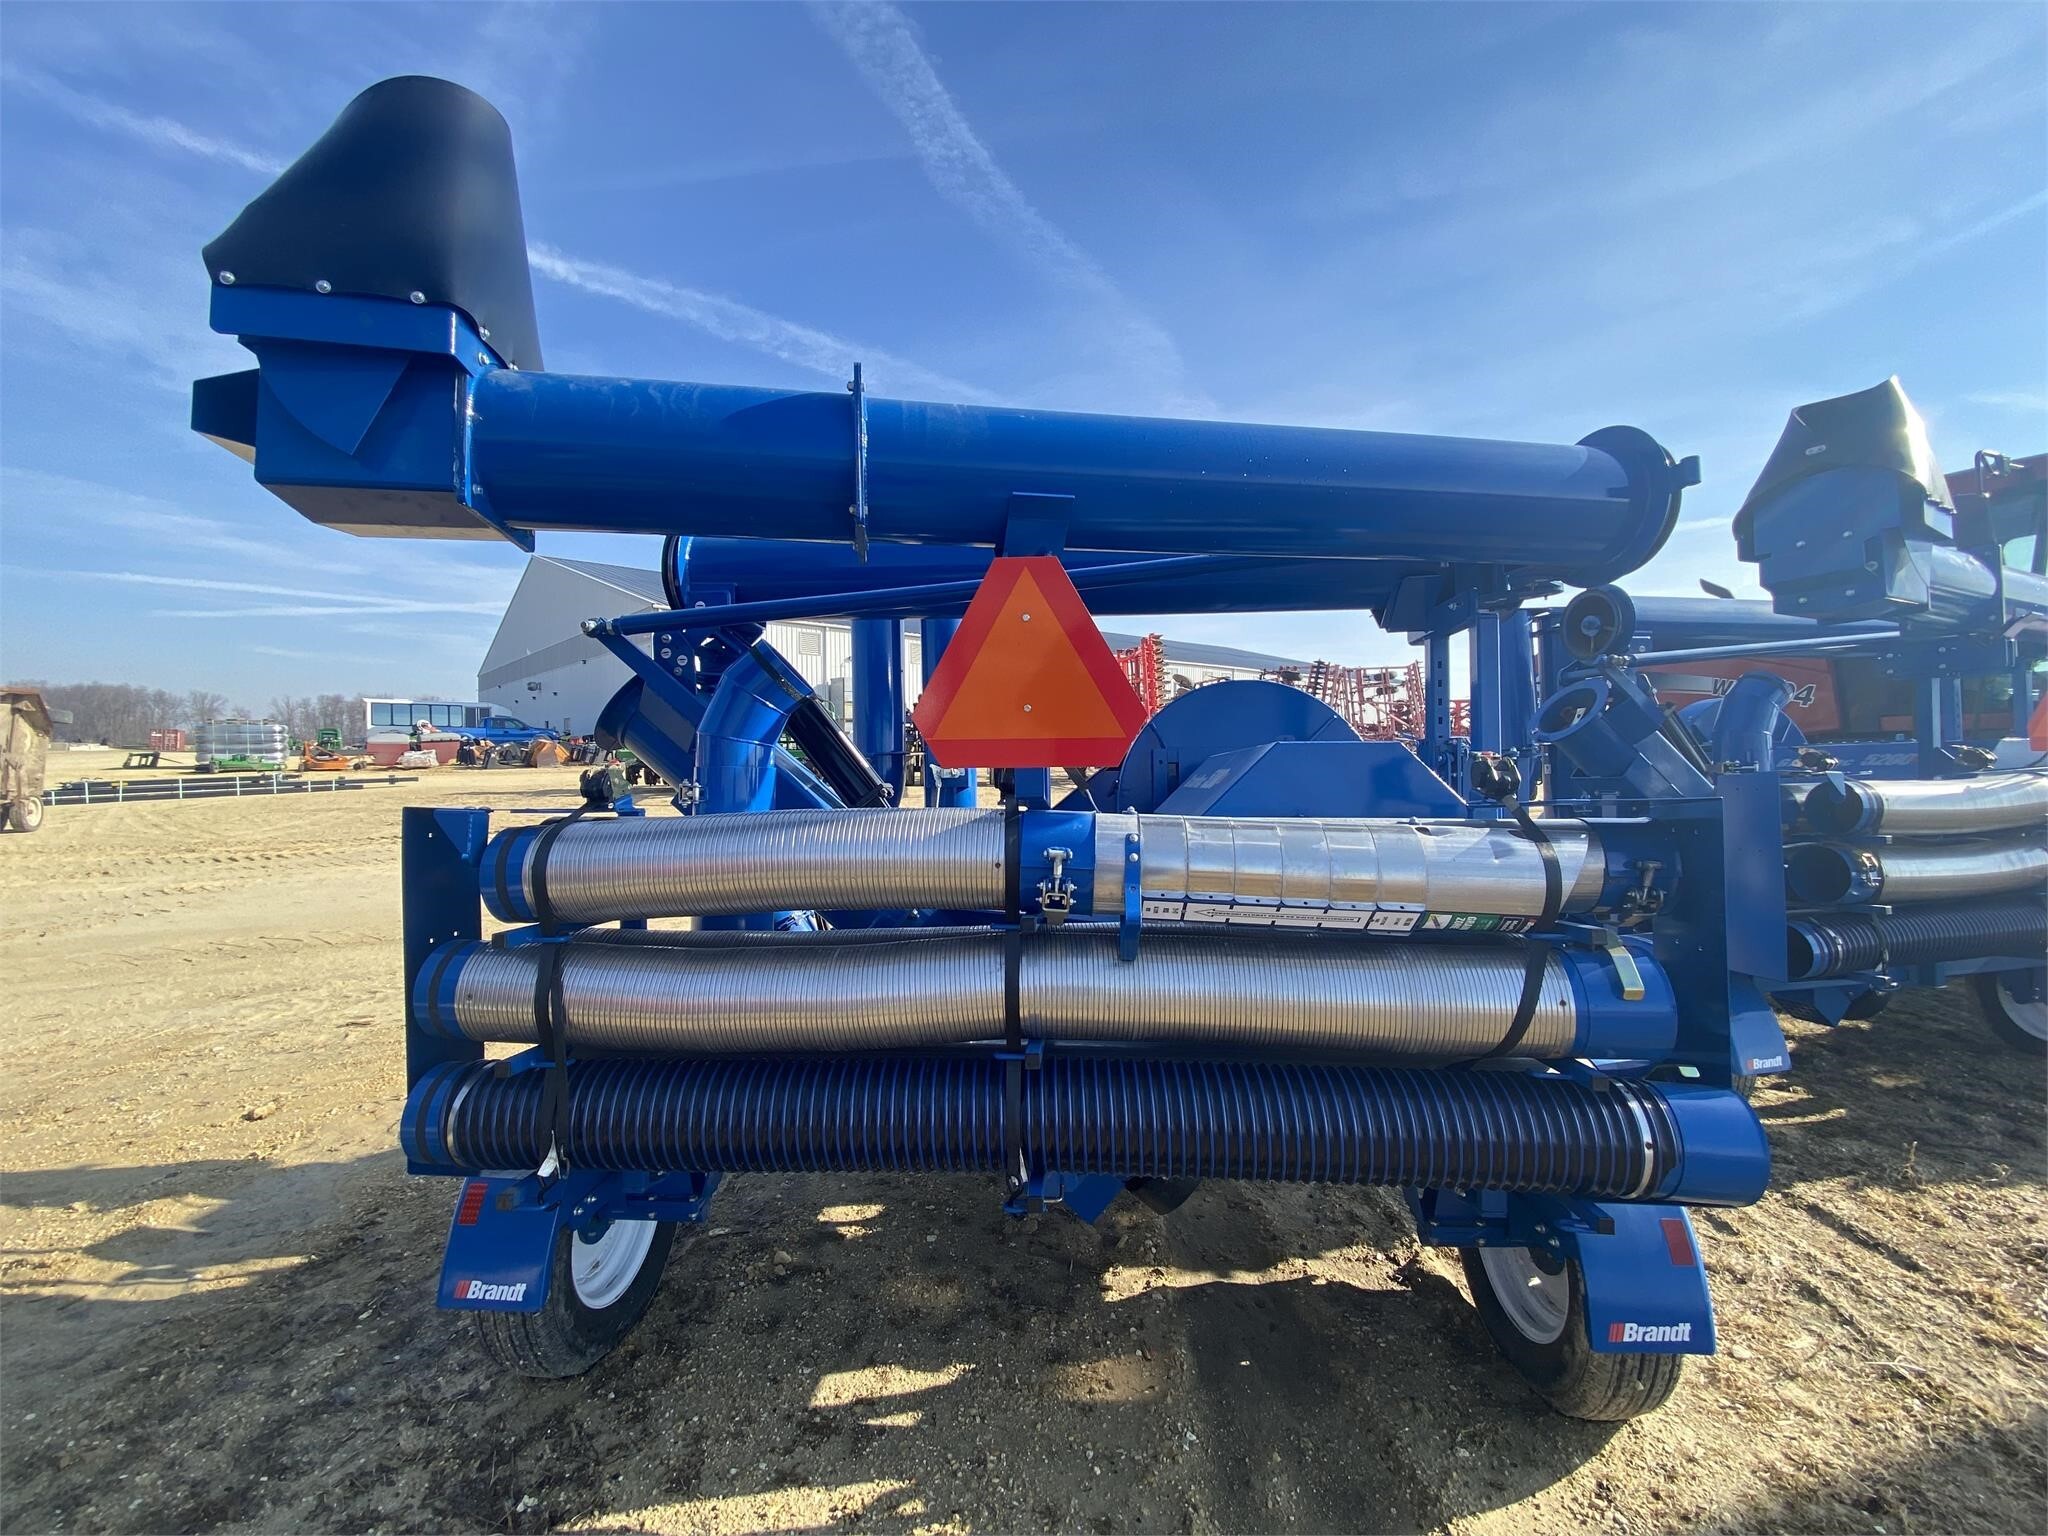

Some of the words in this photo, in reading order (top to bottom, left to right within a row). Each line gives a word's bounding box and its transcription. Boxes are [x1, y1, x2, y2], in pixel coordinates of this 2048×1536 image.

[1753, 1056, 1782, 1069] Brandt
[466, 1280, 527, 1302] Brandt
[1623, 1322, 1691, 1342] Brandt
